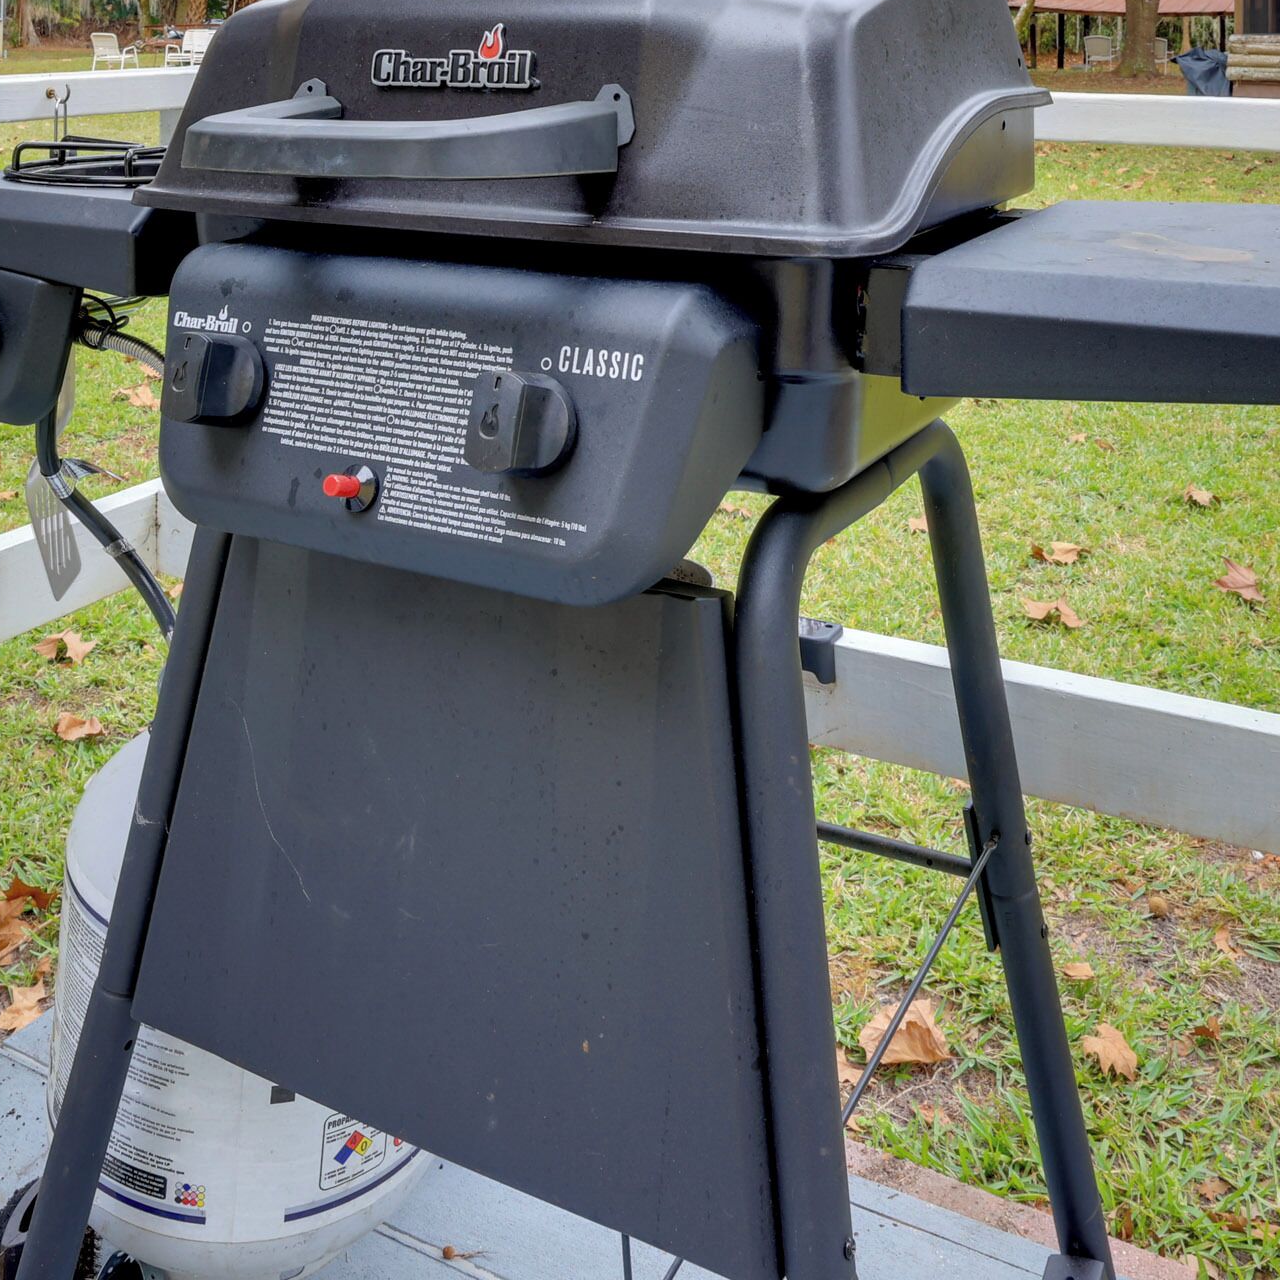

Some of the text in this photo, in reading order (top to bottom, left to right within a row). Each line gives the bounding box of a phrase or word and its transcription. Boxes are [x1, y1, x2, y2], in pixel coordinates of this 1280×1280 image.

[372, 49, 530, 88] Char-Broil
[173, 311, 239, 334] Char-Broil
[558, 345, 644, 382] CLASSIC
